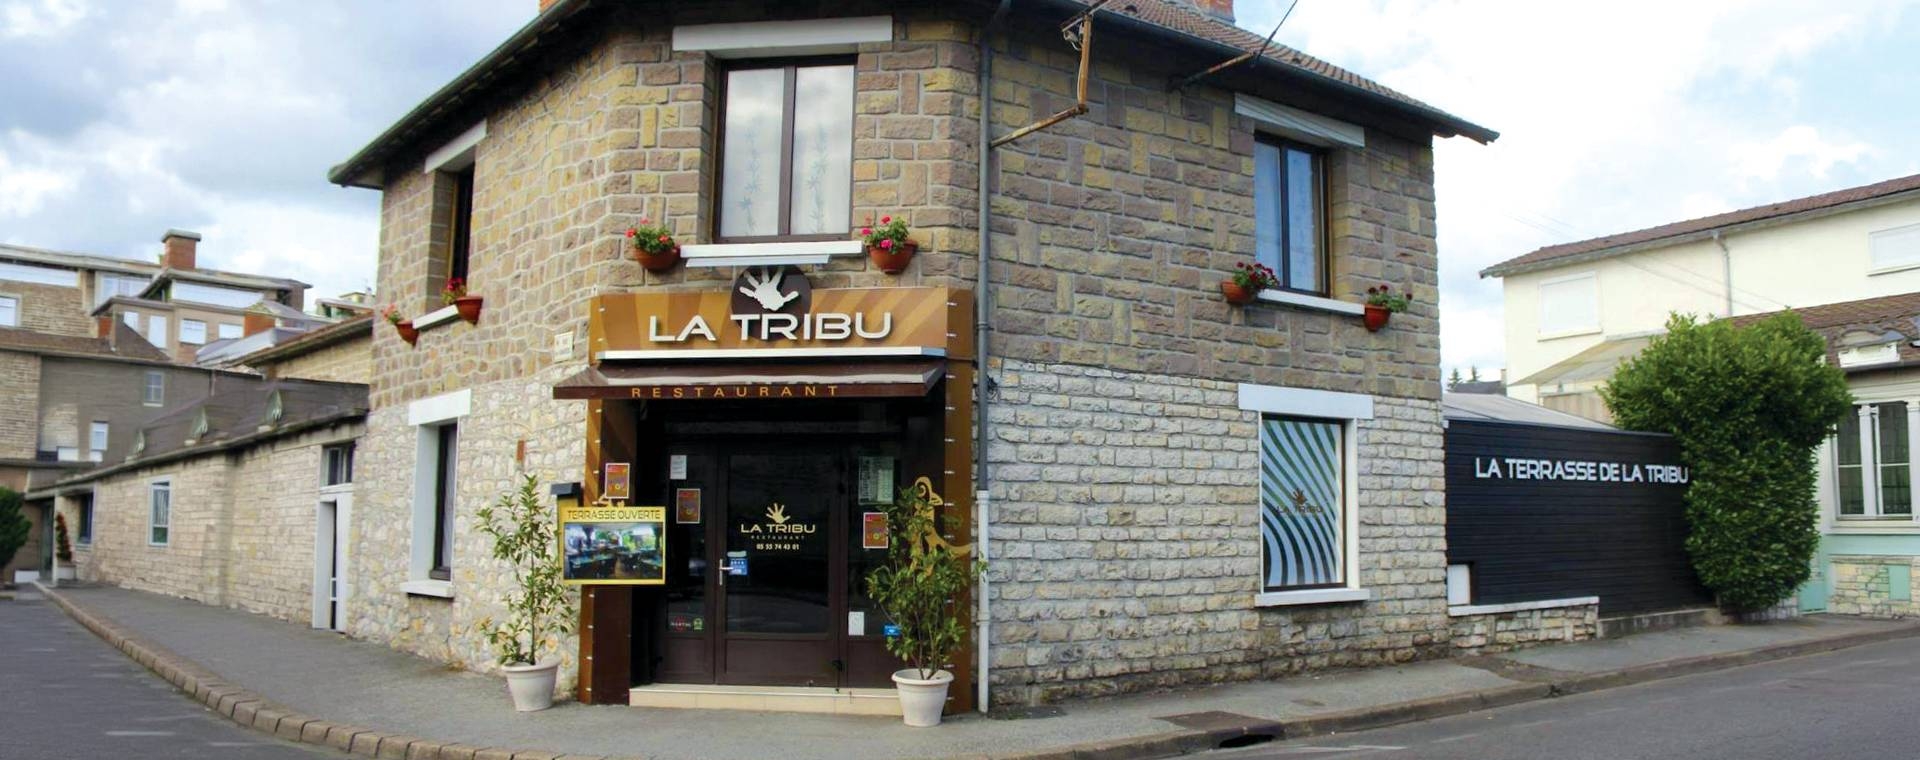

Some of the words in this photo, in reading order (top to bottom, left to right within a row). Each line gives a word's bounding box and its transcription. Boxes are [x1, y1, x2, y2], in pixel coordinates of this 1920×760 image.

[649, 315, 717, 342] LA
[730, 312, 892, 341] TRIBU
[631, 385, 839, 398] RESTAURANT
[1475, 457, 1502, 479] LA
[1505, 458, 1597, 481] TERRASSE
[1599, 462, 1620, 482] DE
[1621, 463, 1643, 482] LA
[1645, 464, 1689, 484] TRIBU
[567, 510, 616, 520] TERRASSE
[617, 509, 661, 519] OUVERTE
[741, 523, 762, 533] LA
[766, 524, 816, 533] TRIBU
